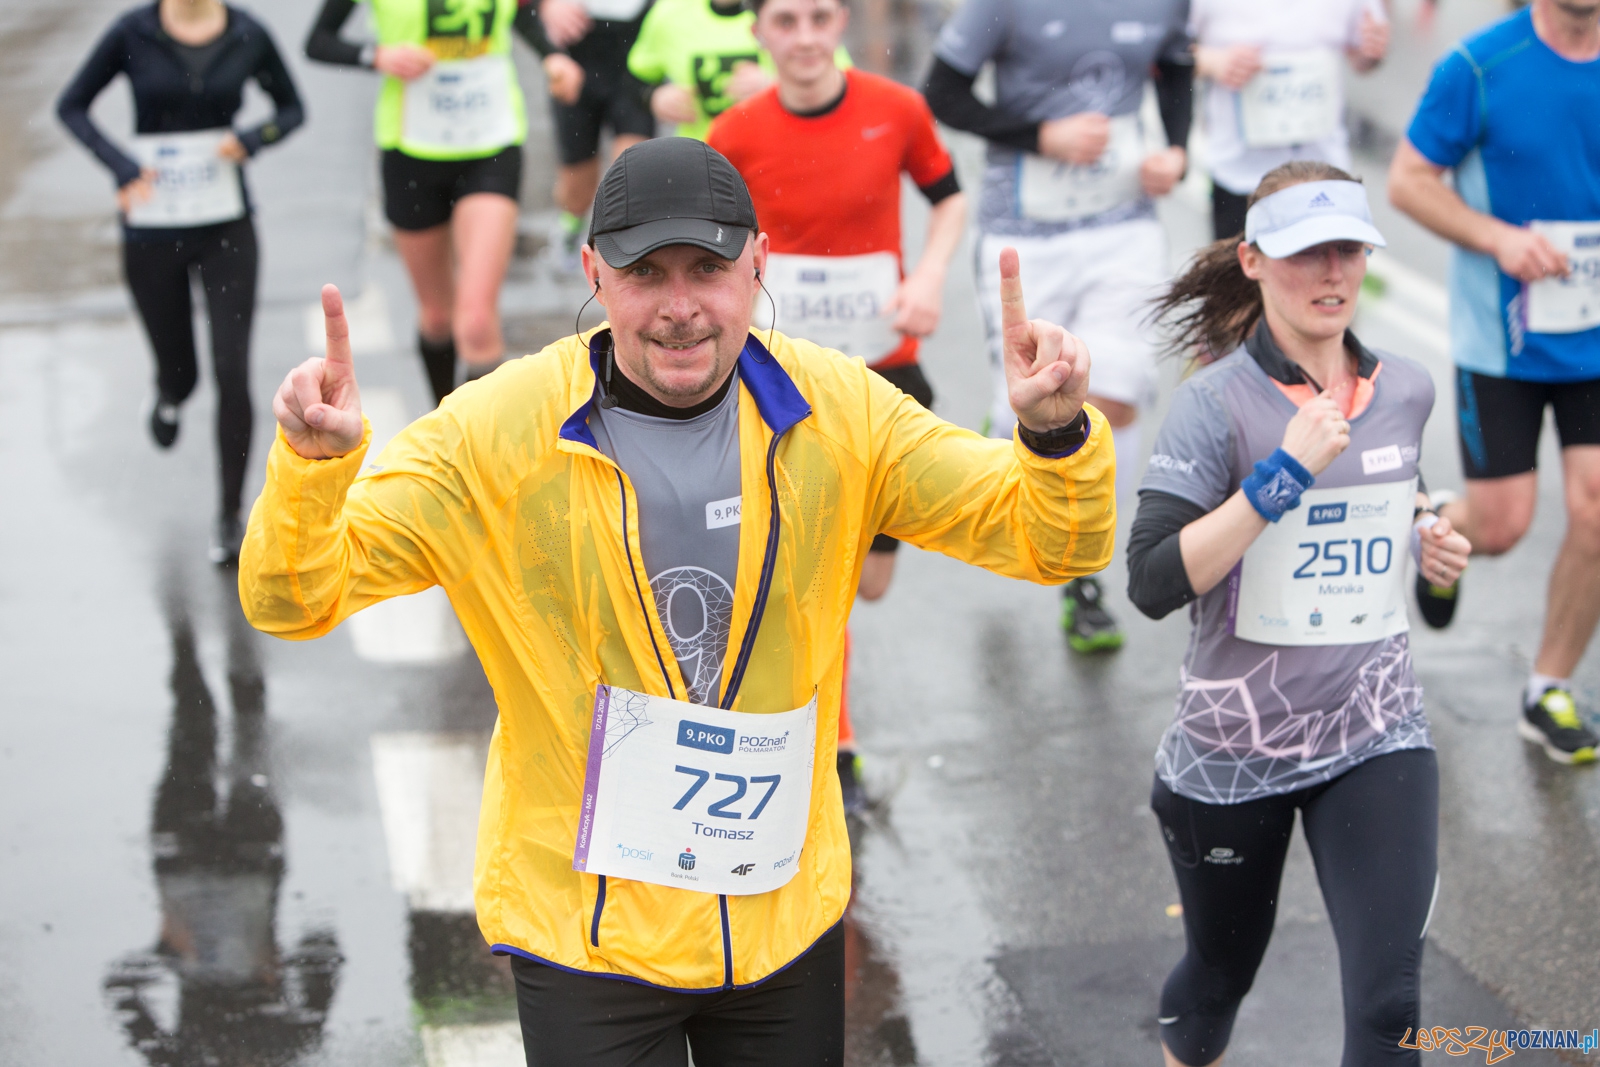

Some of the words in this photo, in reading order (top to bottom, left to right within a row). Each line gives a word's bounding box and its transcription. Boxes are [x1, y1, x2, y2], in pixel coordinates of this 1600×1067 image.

[714, 508, 724, 520] 9.
[725, 504, 741, 518] PK
[1322, 507, 1343, 520] PKO
[1293, 536, 1393, 579] 2510
[1318, 583, 1365, 595] Monika
[686, 728, 696, 742] 9.
[697, 731, 726, 746] PKO
[738, 745, 786, 753] PÓŁMARATON
[672, 764, 782, 820] 727
[691, 821, 754, 841] Tomasz
[730, 863, 756, 876] 4F
